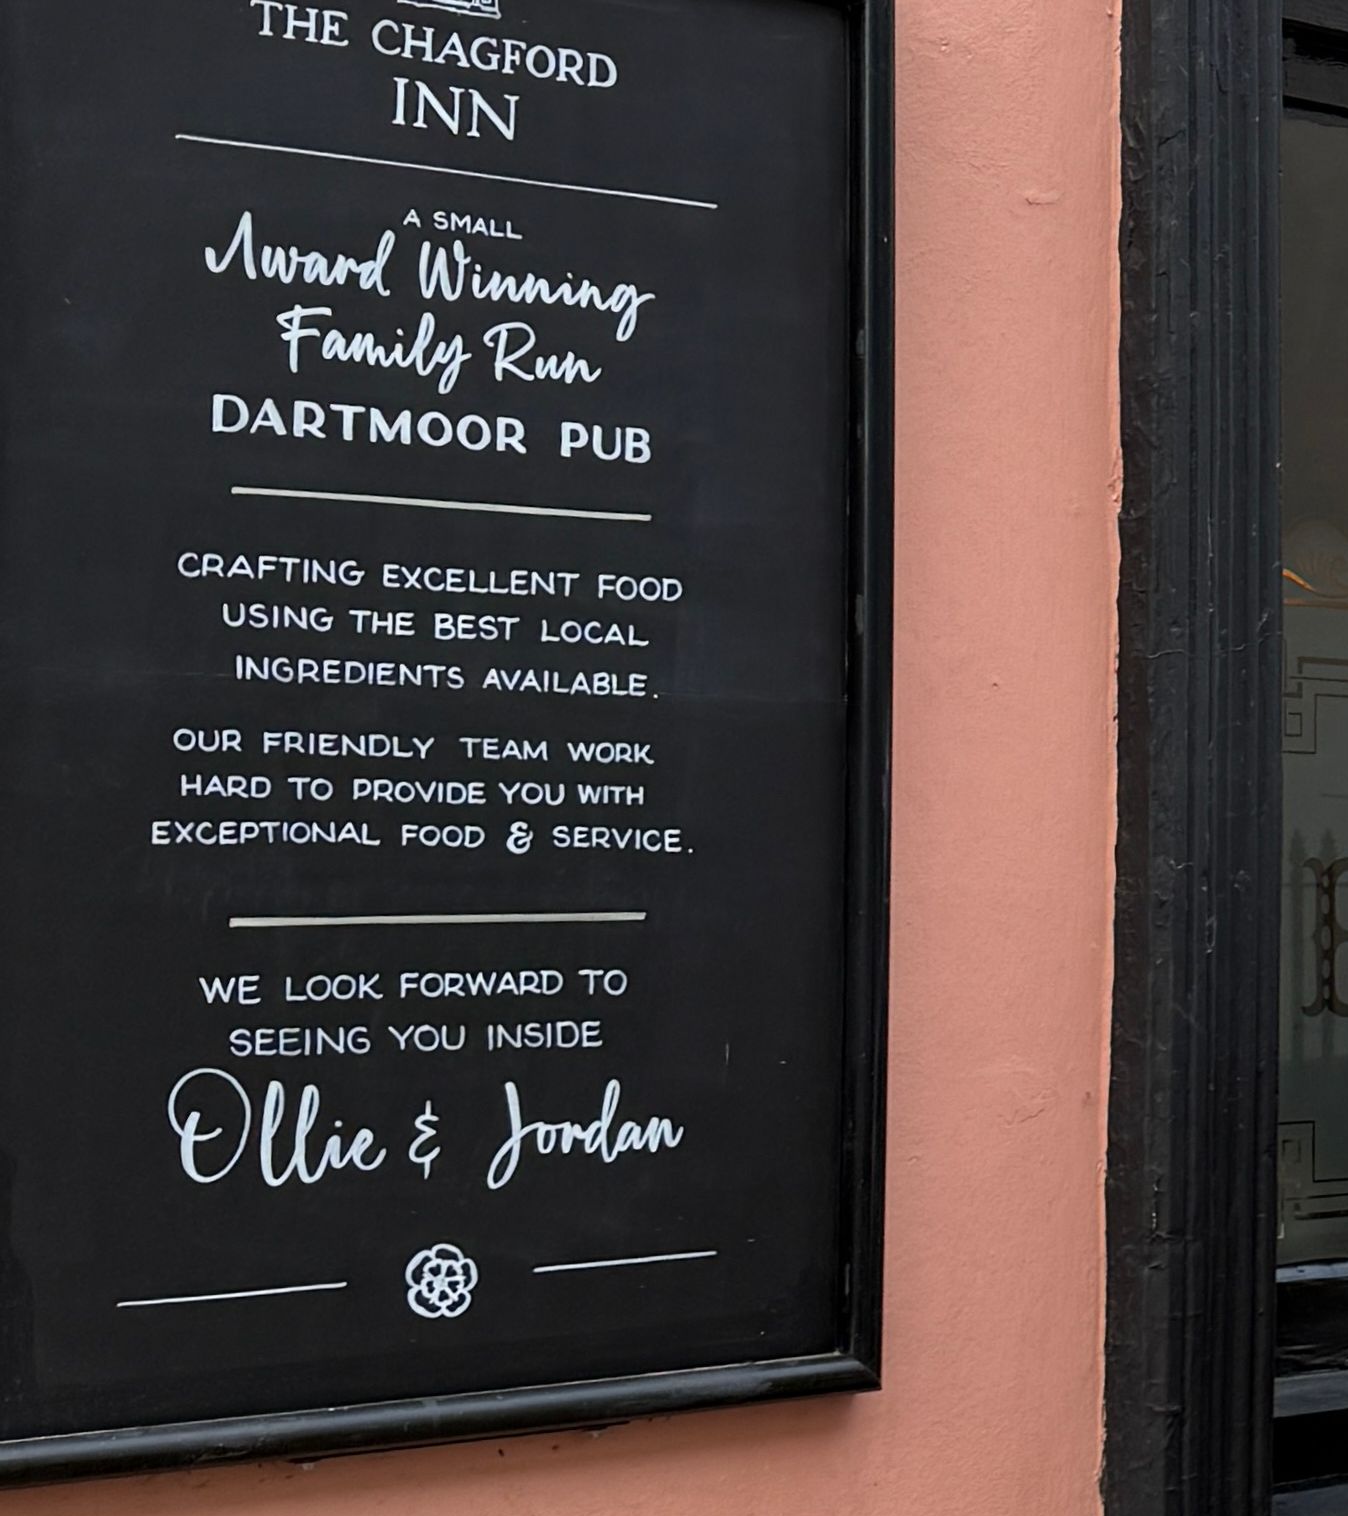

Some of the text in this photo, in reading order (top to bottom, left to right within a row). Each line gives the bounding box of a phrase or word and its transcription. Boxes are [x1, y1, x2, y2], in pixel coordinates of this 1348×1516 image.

[250, 0, 618, 88] THE CHAGFORD
[392, 77, 519, 140] INN
[403, 209, 522, 241] A SMALL
[205, 211, 655, 341] Award Winning
[276, 305, 601, 394] Family Run
[212, 394, 651, 463] DARTMOOR PUB
[178, 553, 682, 601] CRAFTING EXCELLENT FOOD
[223, 603, 649, 646] USING THE BEST LOCAL
[236, 655, 658, 698] INGREDIENTS AVAILABLE.
[174, 729, 654, 764] OUR FRIENDLY TEAM WORK
[181, 775, 643, 805] HARD TO PROVIDE YOU WITH
[152, 821, 693, 854] EXCEPTIONAL FOOD & SERVICE.
[199, 969, 627, 1004] WE LOOK FORWARD TO
[230, 1021, 602, 1056] SEEING YOU INSIDE
[168, 1068, 683, 1189] Ollie & Jordan
